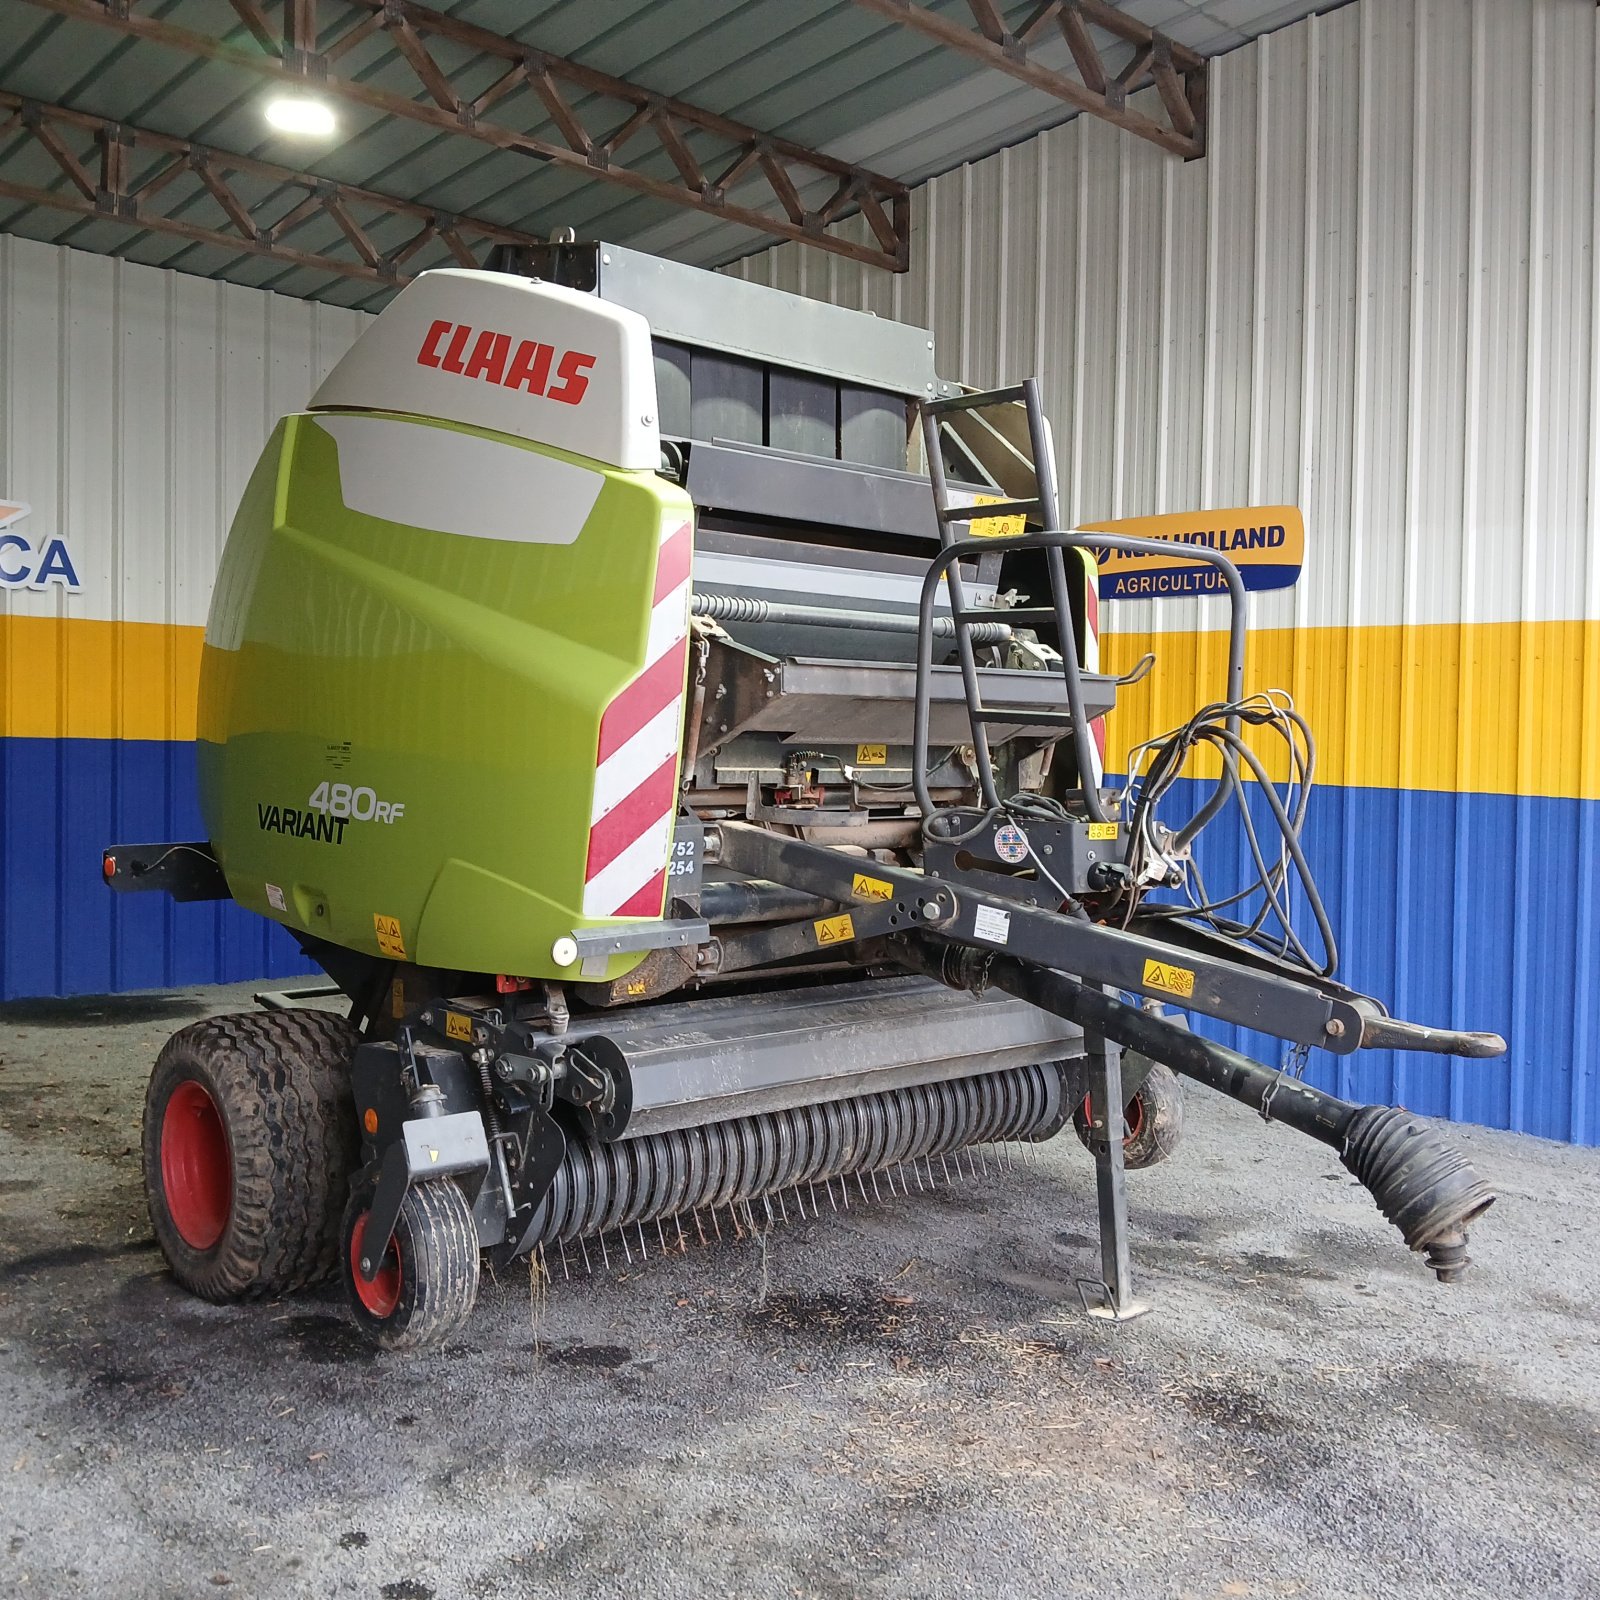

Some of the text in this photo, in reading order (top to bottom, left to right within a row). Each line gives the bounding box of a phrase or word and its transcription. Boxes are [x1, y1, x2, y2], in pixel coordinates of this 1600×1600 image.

[417, 319, 597, 406] CLAAS
[1115, 571, 1242, 594] AGRICULTUR
[257, 803, 350, 845] VARIANT
[668, 860, 695, 876] 254
